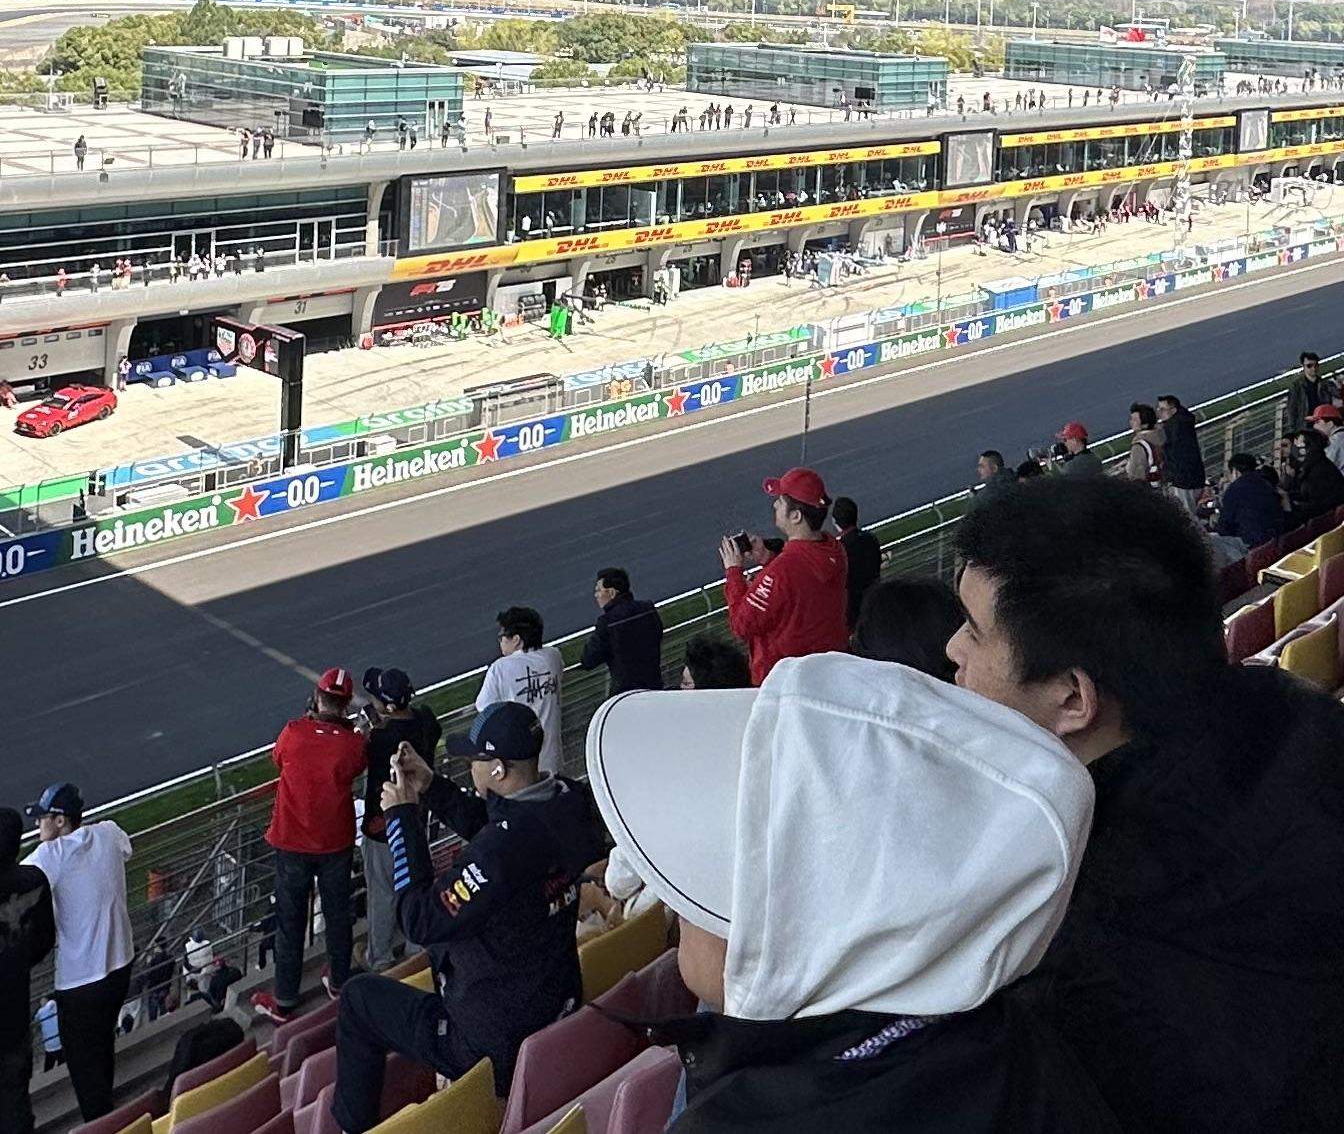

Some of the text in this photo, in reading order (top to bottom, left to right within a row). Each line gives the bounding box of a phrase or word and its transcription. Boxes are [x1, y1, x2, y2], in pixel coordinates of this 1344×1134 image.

[426, 254, 488, 273] DHL
[555, 237, 600, 254] DHL
[635, 228, 674, 243] DHL
[705, 219, 742, 233] DHL
[770, 211, 803, 225] DHL
[830, 204, 860, 217] DHL
[884, 197, 913, 210] DHL
[294, 300, 307, 315] 31
[28, 354, 49, 371] 33
[880, 335, 940, 362] Heineken
[741, 365, 812, 397] Heineken
[570, 401, 659, 439] Heineken
[352, 446, 466, 492] Heineken
[71, 505, 220, 560] Heineken
